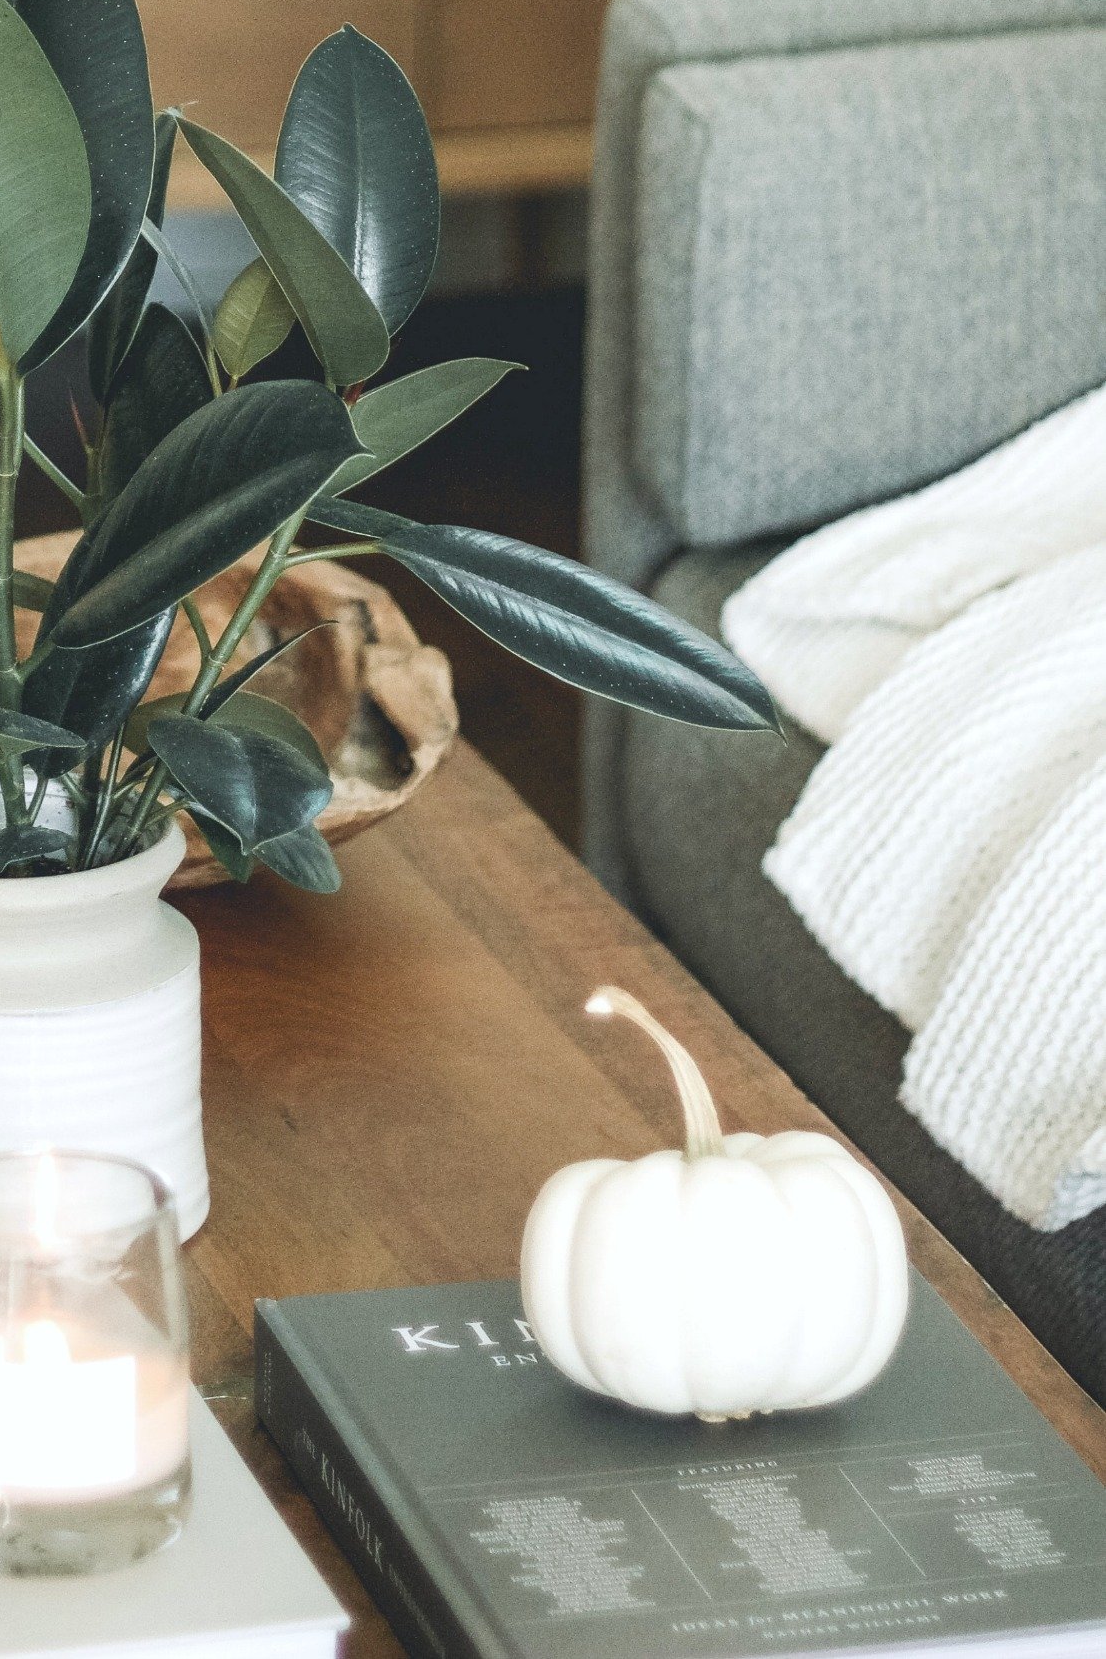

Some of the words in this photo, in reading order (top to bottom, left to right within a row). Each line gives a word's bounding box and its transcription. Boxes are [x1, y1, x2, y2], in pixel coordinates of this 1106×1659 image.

[677, 1460, 778, 1476] FEATURING
[321, 1452, 384, 1574] KINFOLK
[671, 1617, 739, 1633] IDEAS
[781, 1597, 933, 1622] MEANINGFUL
[942, 1590, 1008, 1604] WORK
[846, 1613, 941, 1632] WILLIAMS
